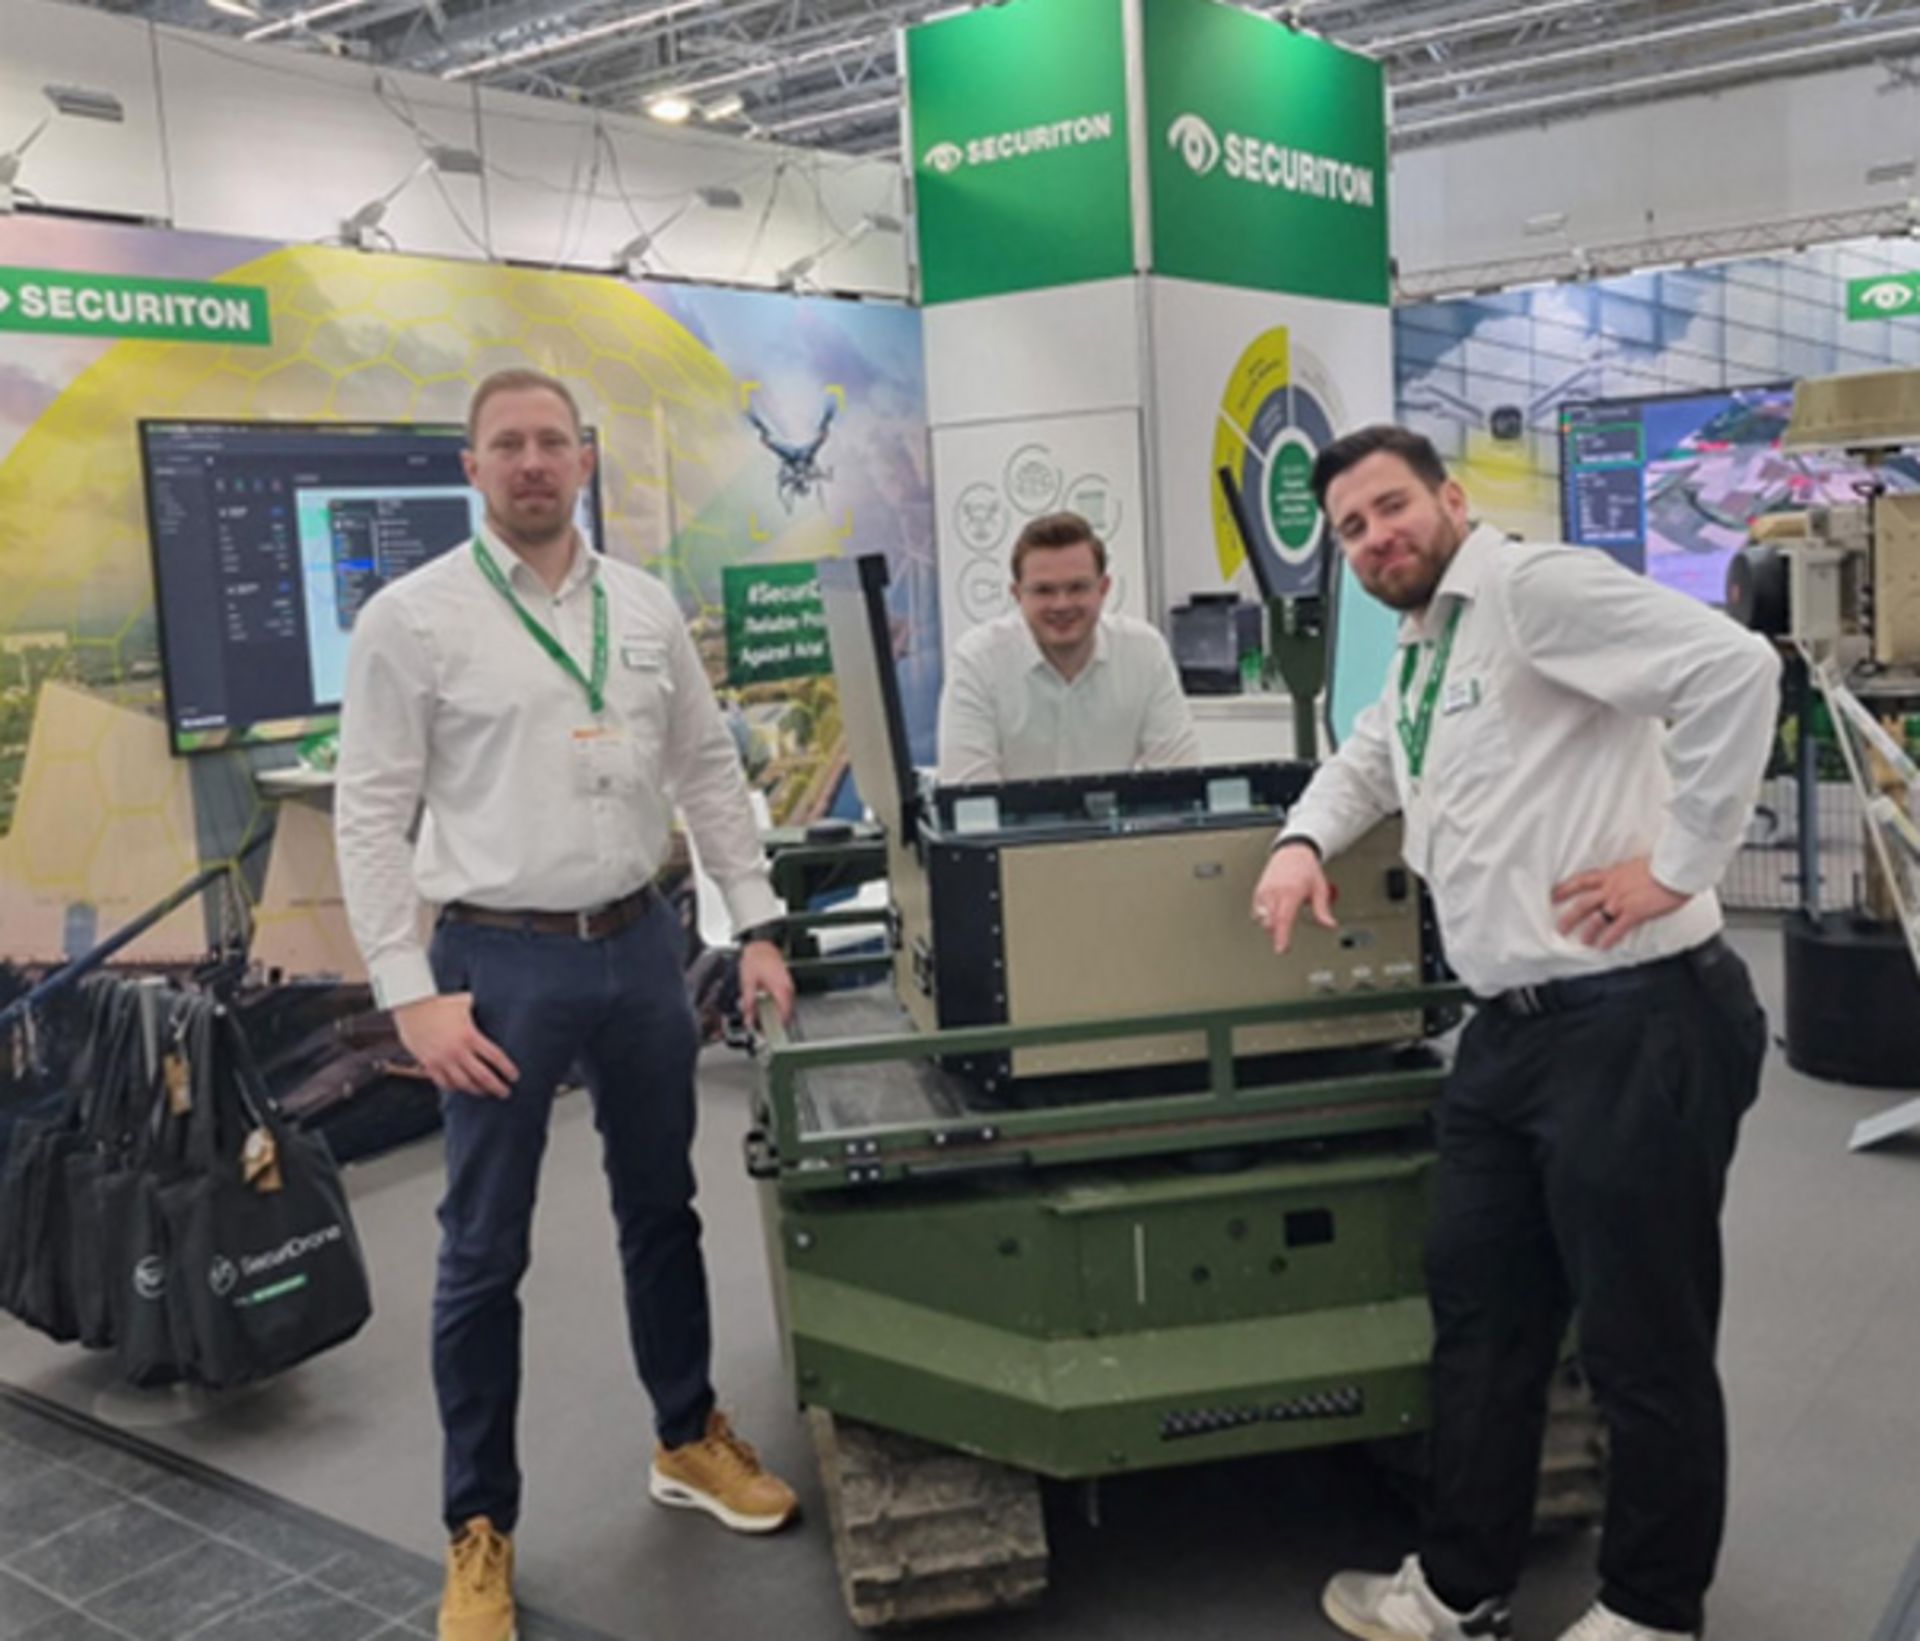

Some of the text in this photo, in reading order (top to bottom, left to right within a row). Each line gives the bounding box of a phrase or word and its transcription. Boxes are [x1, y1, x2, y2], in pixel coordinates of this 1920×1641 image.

[966, 112, 1113, 166] SECURITON
[1222, 132, 1374, 207] SECURITON
[18, 283, 252, 331] SECURITON
[240, 1224, 341, 1274] SecurDrone
